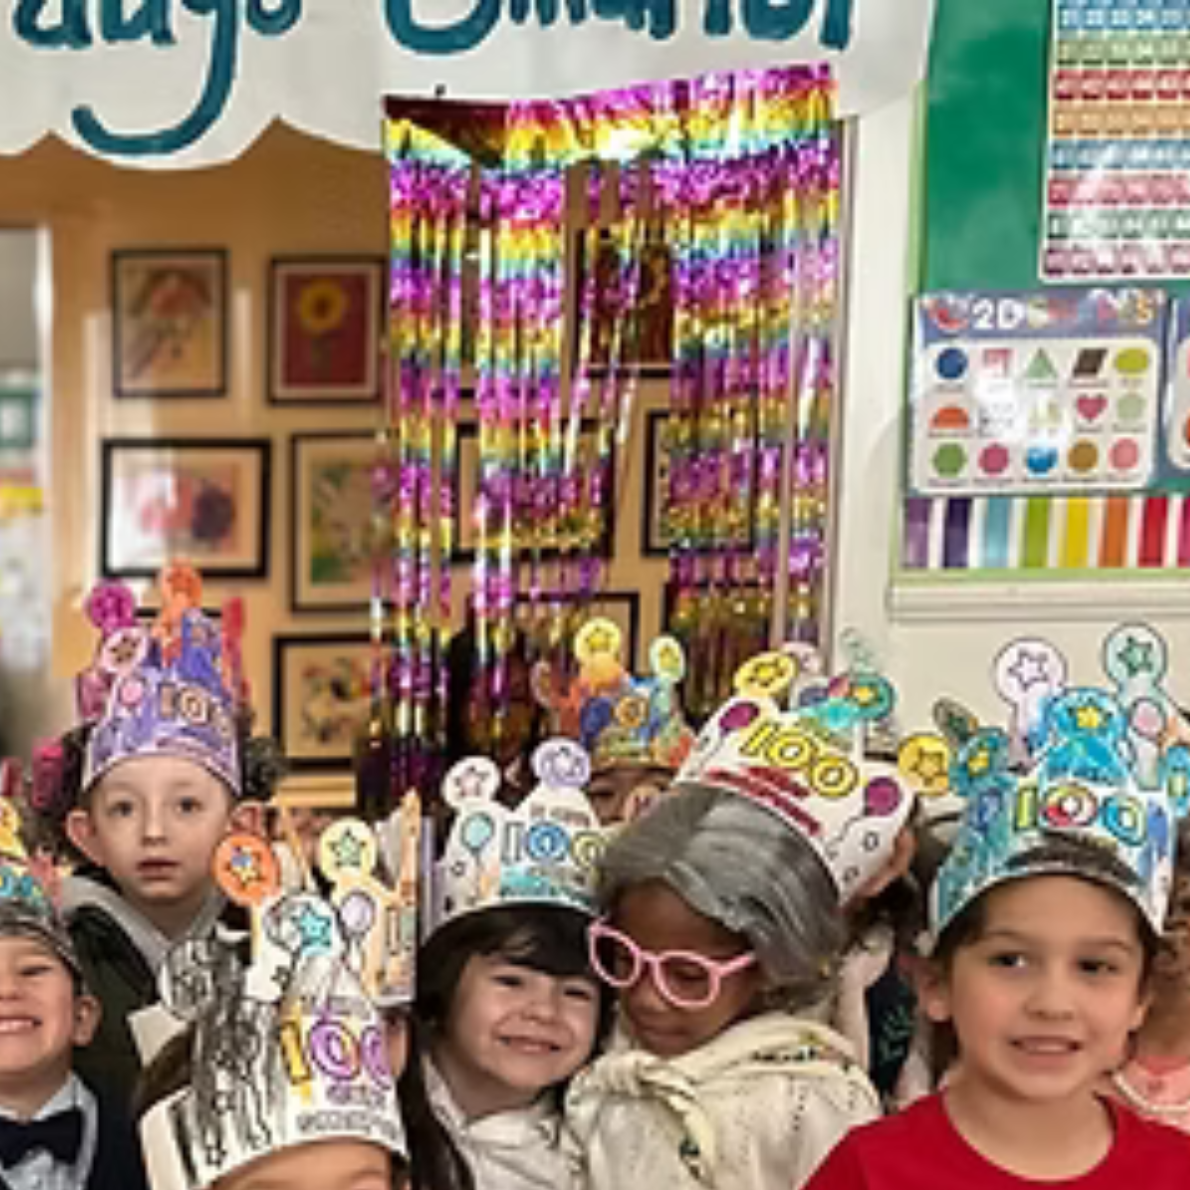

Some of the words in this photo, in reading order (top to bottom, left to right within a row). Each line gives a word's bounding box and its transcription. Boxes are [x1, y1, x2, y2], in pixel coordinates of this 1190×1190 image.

[973, 298, 1025, 330] 2D
[739, 717, 859, 798] 100
[1014, 784, 1149, 846] 100
